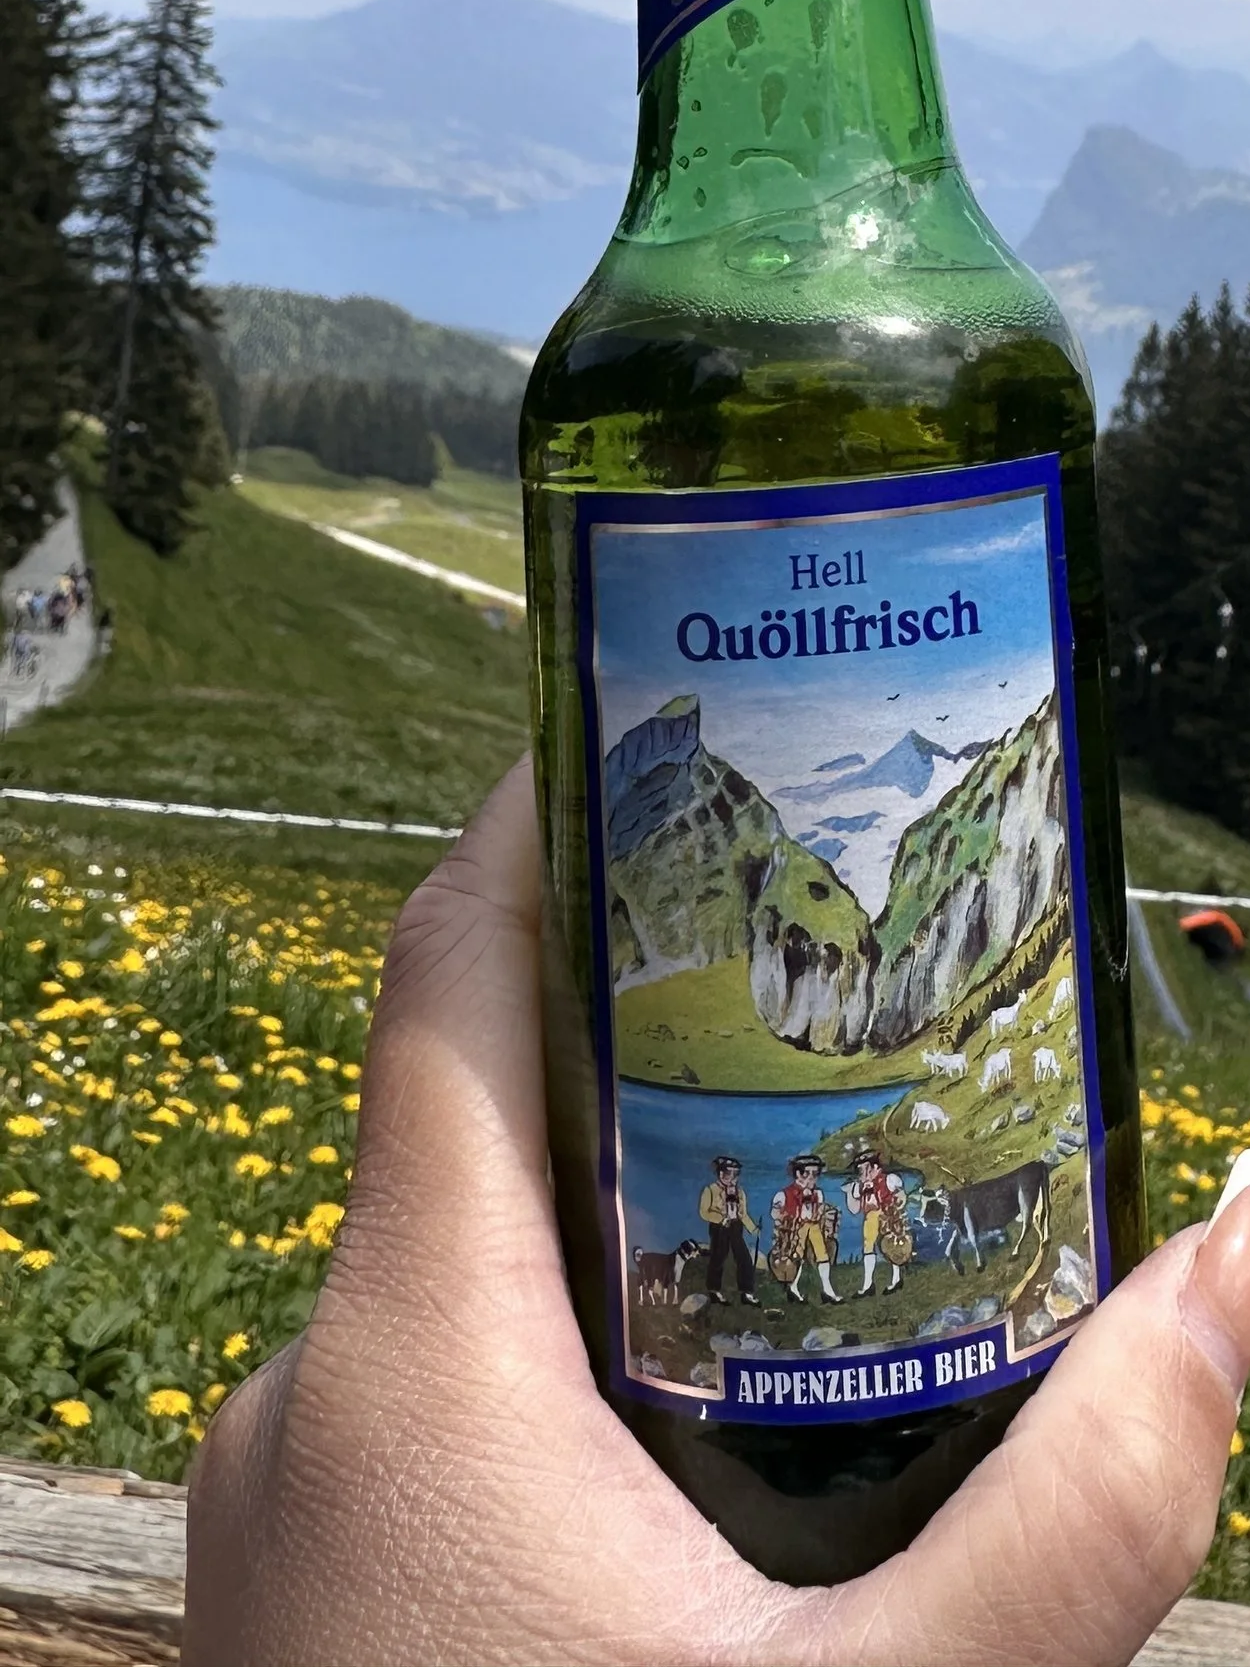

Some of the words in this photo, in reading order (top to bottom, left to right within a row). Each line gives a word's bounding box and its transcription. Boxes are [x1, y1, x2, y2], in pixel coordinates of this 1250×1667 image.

[789, 550, 868, 591] Hell
[677, 590, 983, 662] Quöllfrisch
[738, 1359, 924, 1405] APPENZELLER
[935, 1340, 996, 1387] BIER
